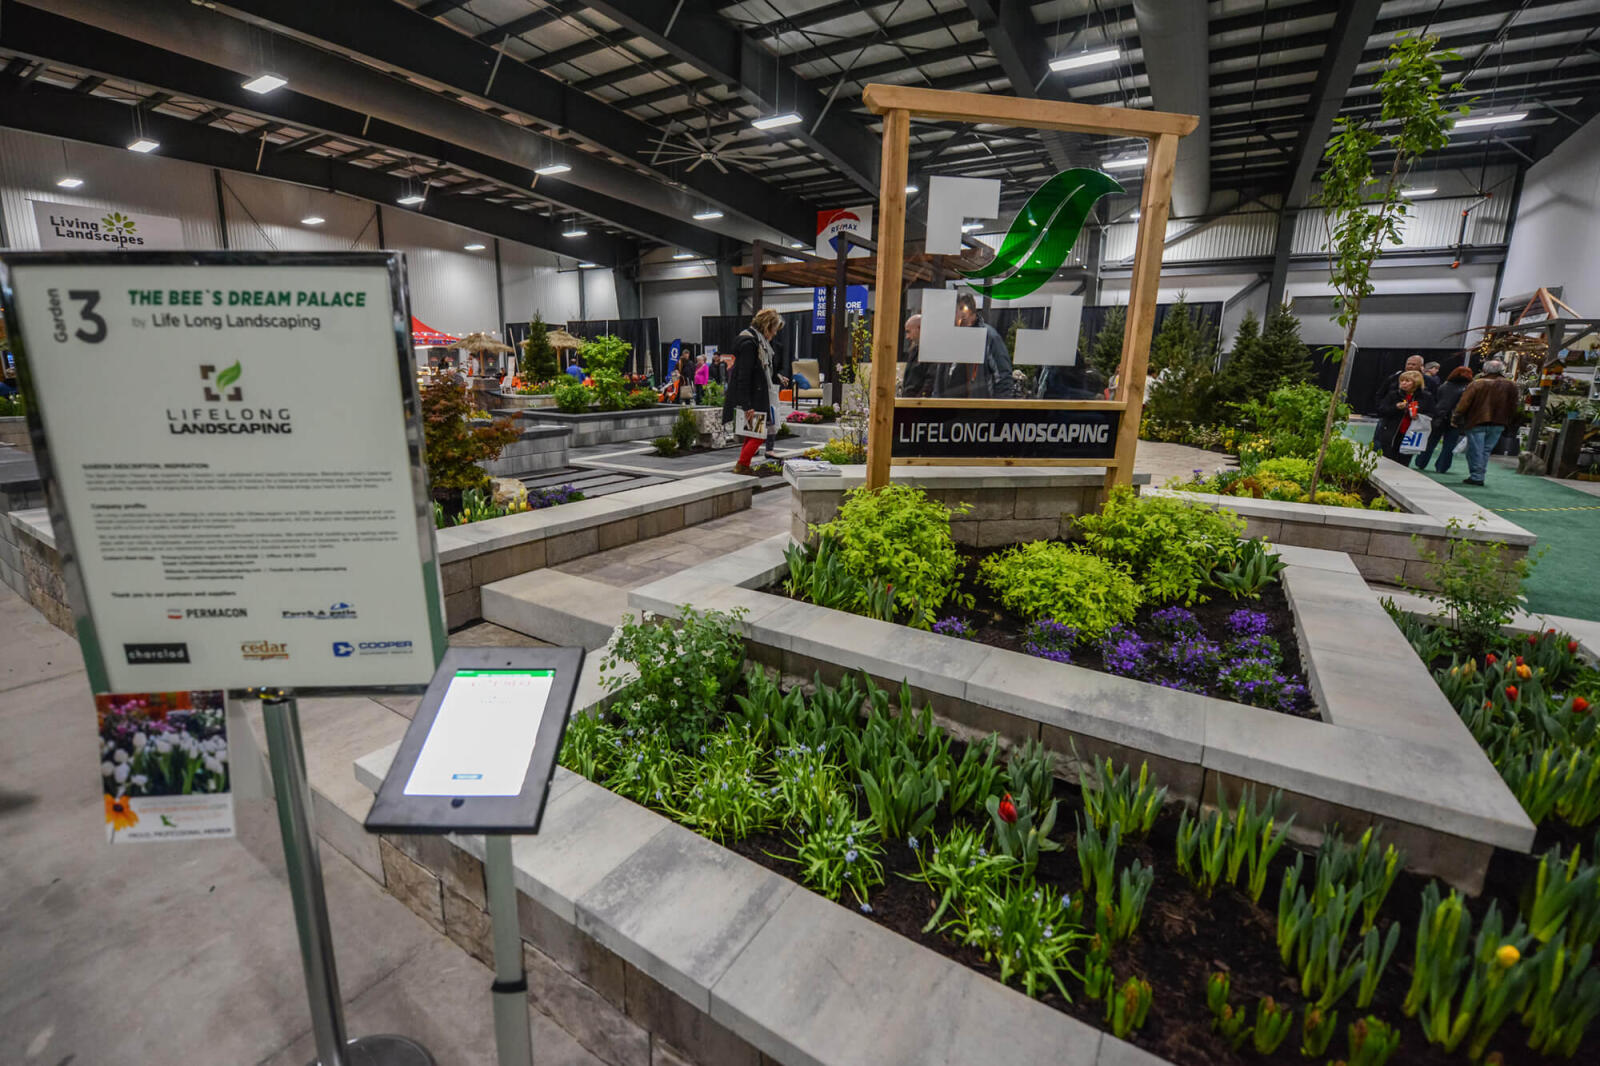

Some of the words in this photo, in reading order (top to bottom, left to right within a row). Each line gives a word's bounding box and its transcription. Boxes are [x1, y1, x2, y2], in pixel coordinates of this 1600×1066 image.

[50, 215, 99, 232] Living
[55, 226, 144, 248] Landscapes
[128, 290, 164, 306] THE
[228, 291, 291, 306] DREAM
[297, 292, 367, 307] PALACE
[48, 288, 69, 343] Garden
[68, 289, 107, 344] 3
[131, 316, 146, 328] by
[152, 313, 181, 328] Life
[184, 313, 222, 330] Long
[226, 313, 321, 331] Landscaping
[166, 408, 290, 421] LIFELONG
[169, 422, 292, 435] LANDSCAPING
[1400, 431, 1423, 447] ell
[185, 607, 248, 619] PERMACON
[241, 640, 288, 653] cedar
[358, 641, 413, 650] COOPER
